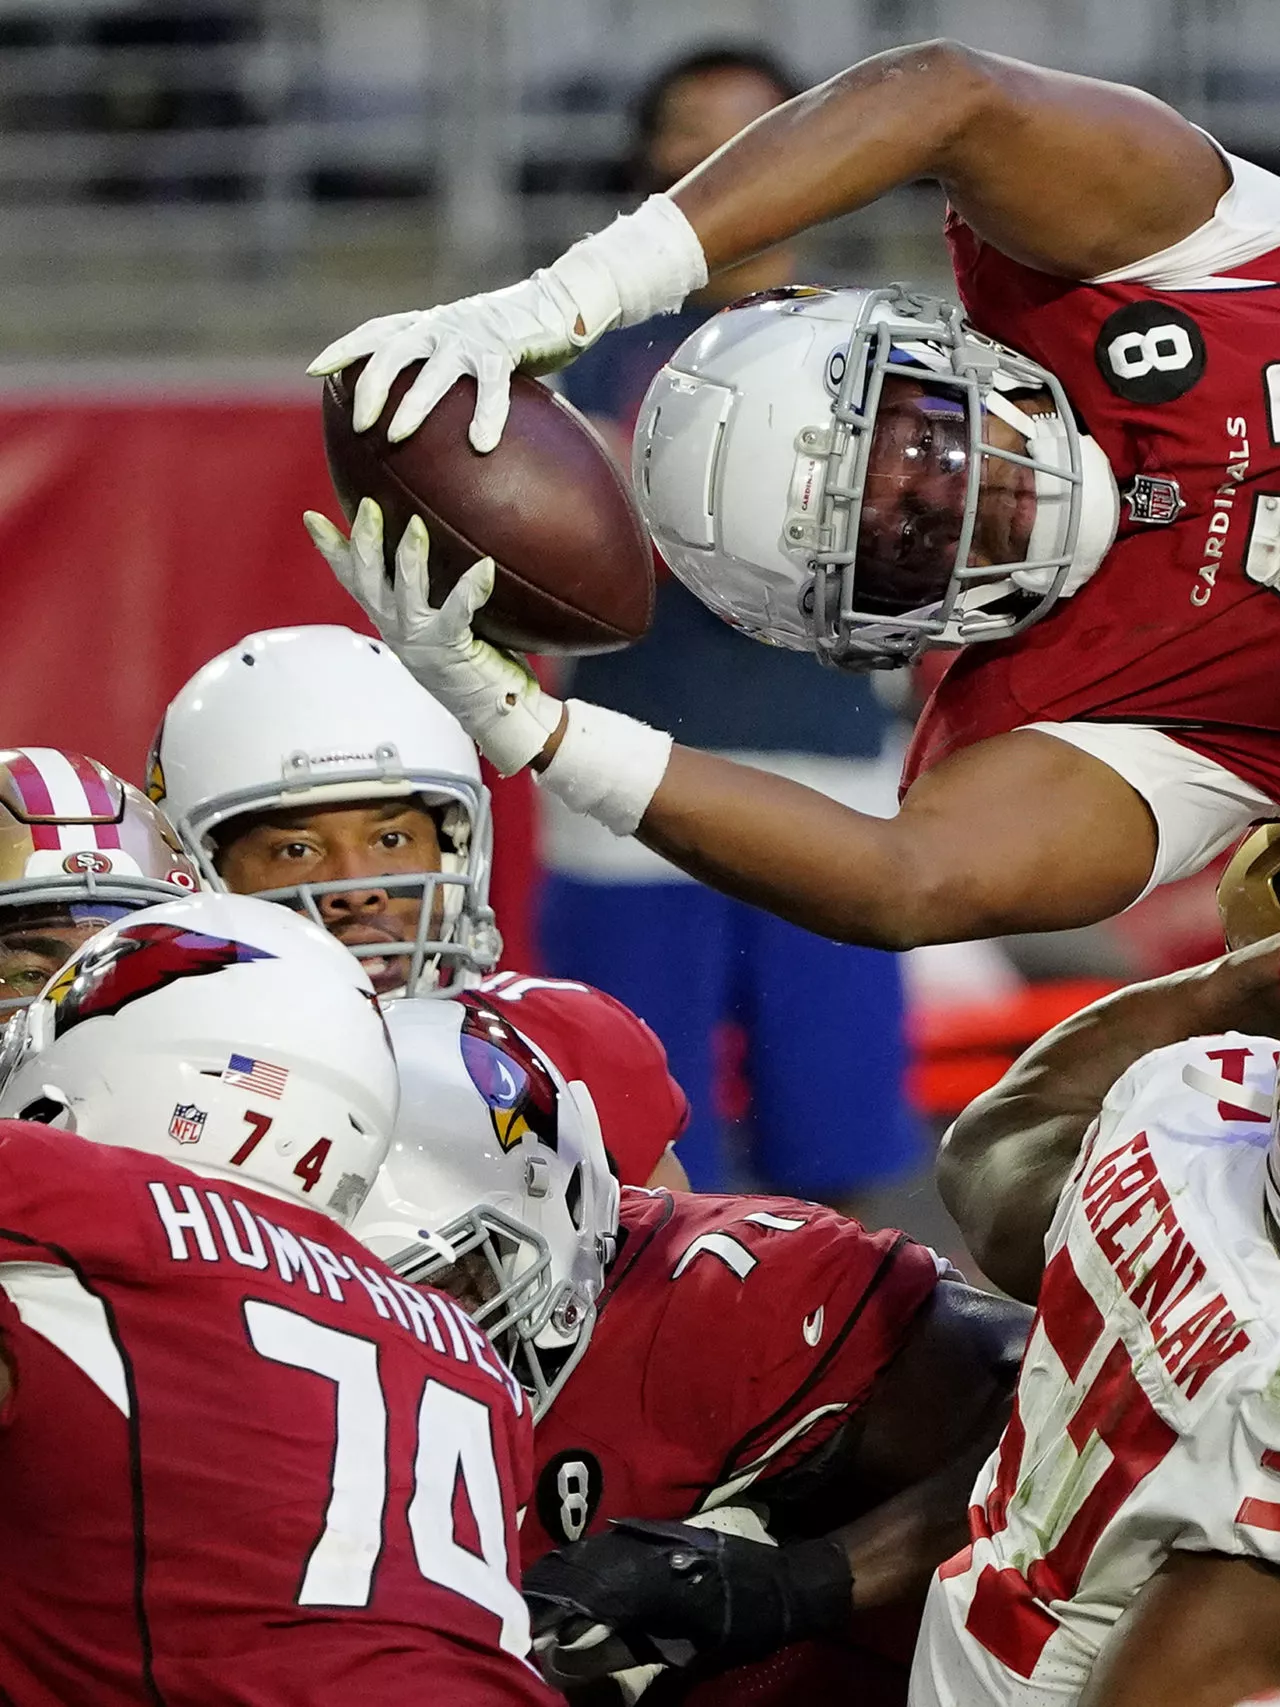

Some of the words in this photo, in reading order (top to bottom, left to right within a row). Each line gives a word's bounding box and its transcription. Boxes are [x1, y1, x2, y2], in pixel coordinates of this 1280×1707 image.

[1107, 323, 1194, 380] 8
[1190, 416, 1250, 607] CARDINALS
[170, 1118, 198, 1142] NFL
[1081, 1130, 1252, 1402] GREENLAW
[242, 1297, 545, 1683] 74
[557, 1460, 590, 1542] 8
